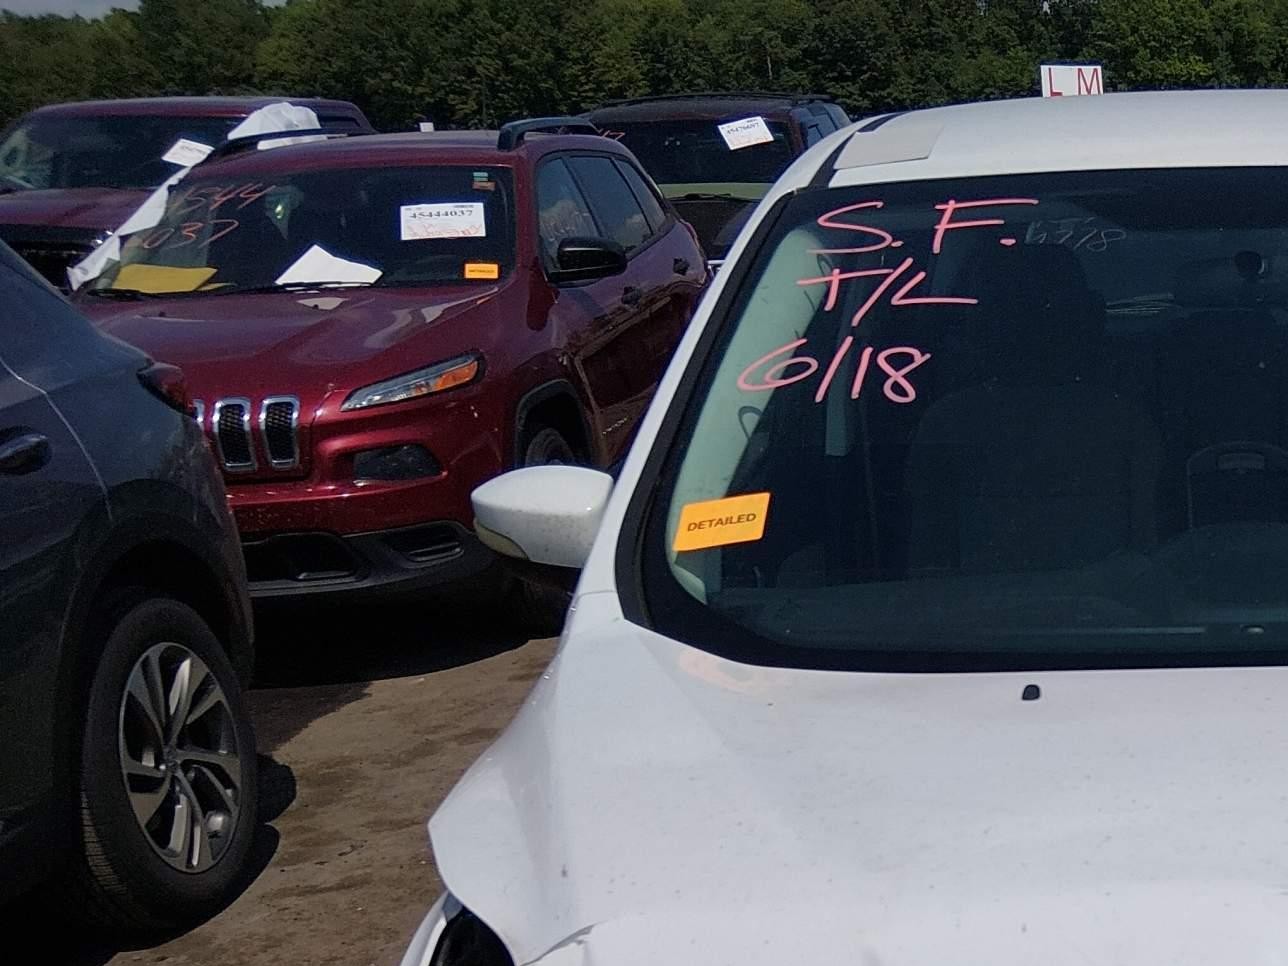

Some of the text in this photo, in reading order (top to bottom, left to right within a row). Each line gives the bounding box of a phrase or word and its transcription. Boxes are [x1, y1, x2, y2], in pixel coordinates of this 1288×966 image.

[1048, 67, 1101, 96] L M
[409, 209, 474, 219] 45444037
[736, 335, 932, 404] 6/18
[686, 512, 758, 533] DETAILED
